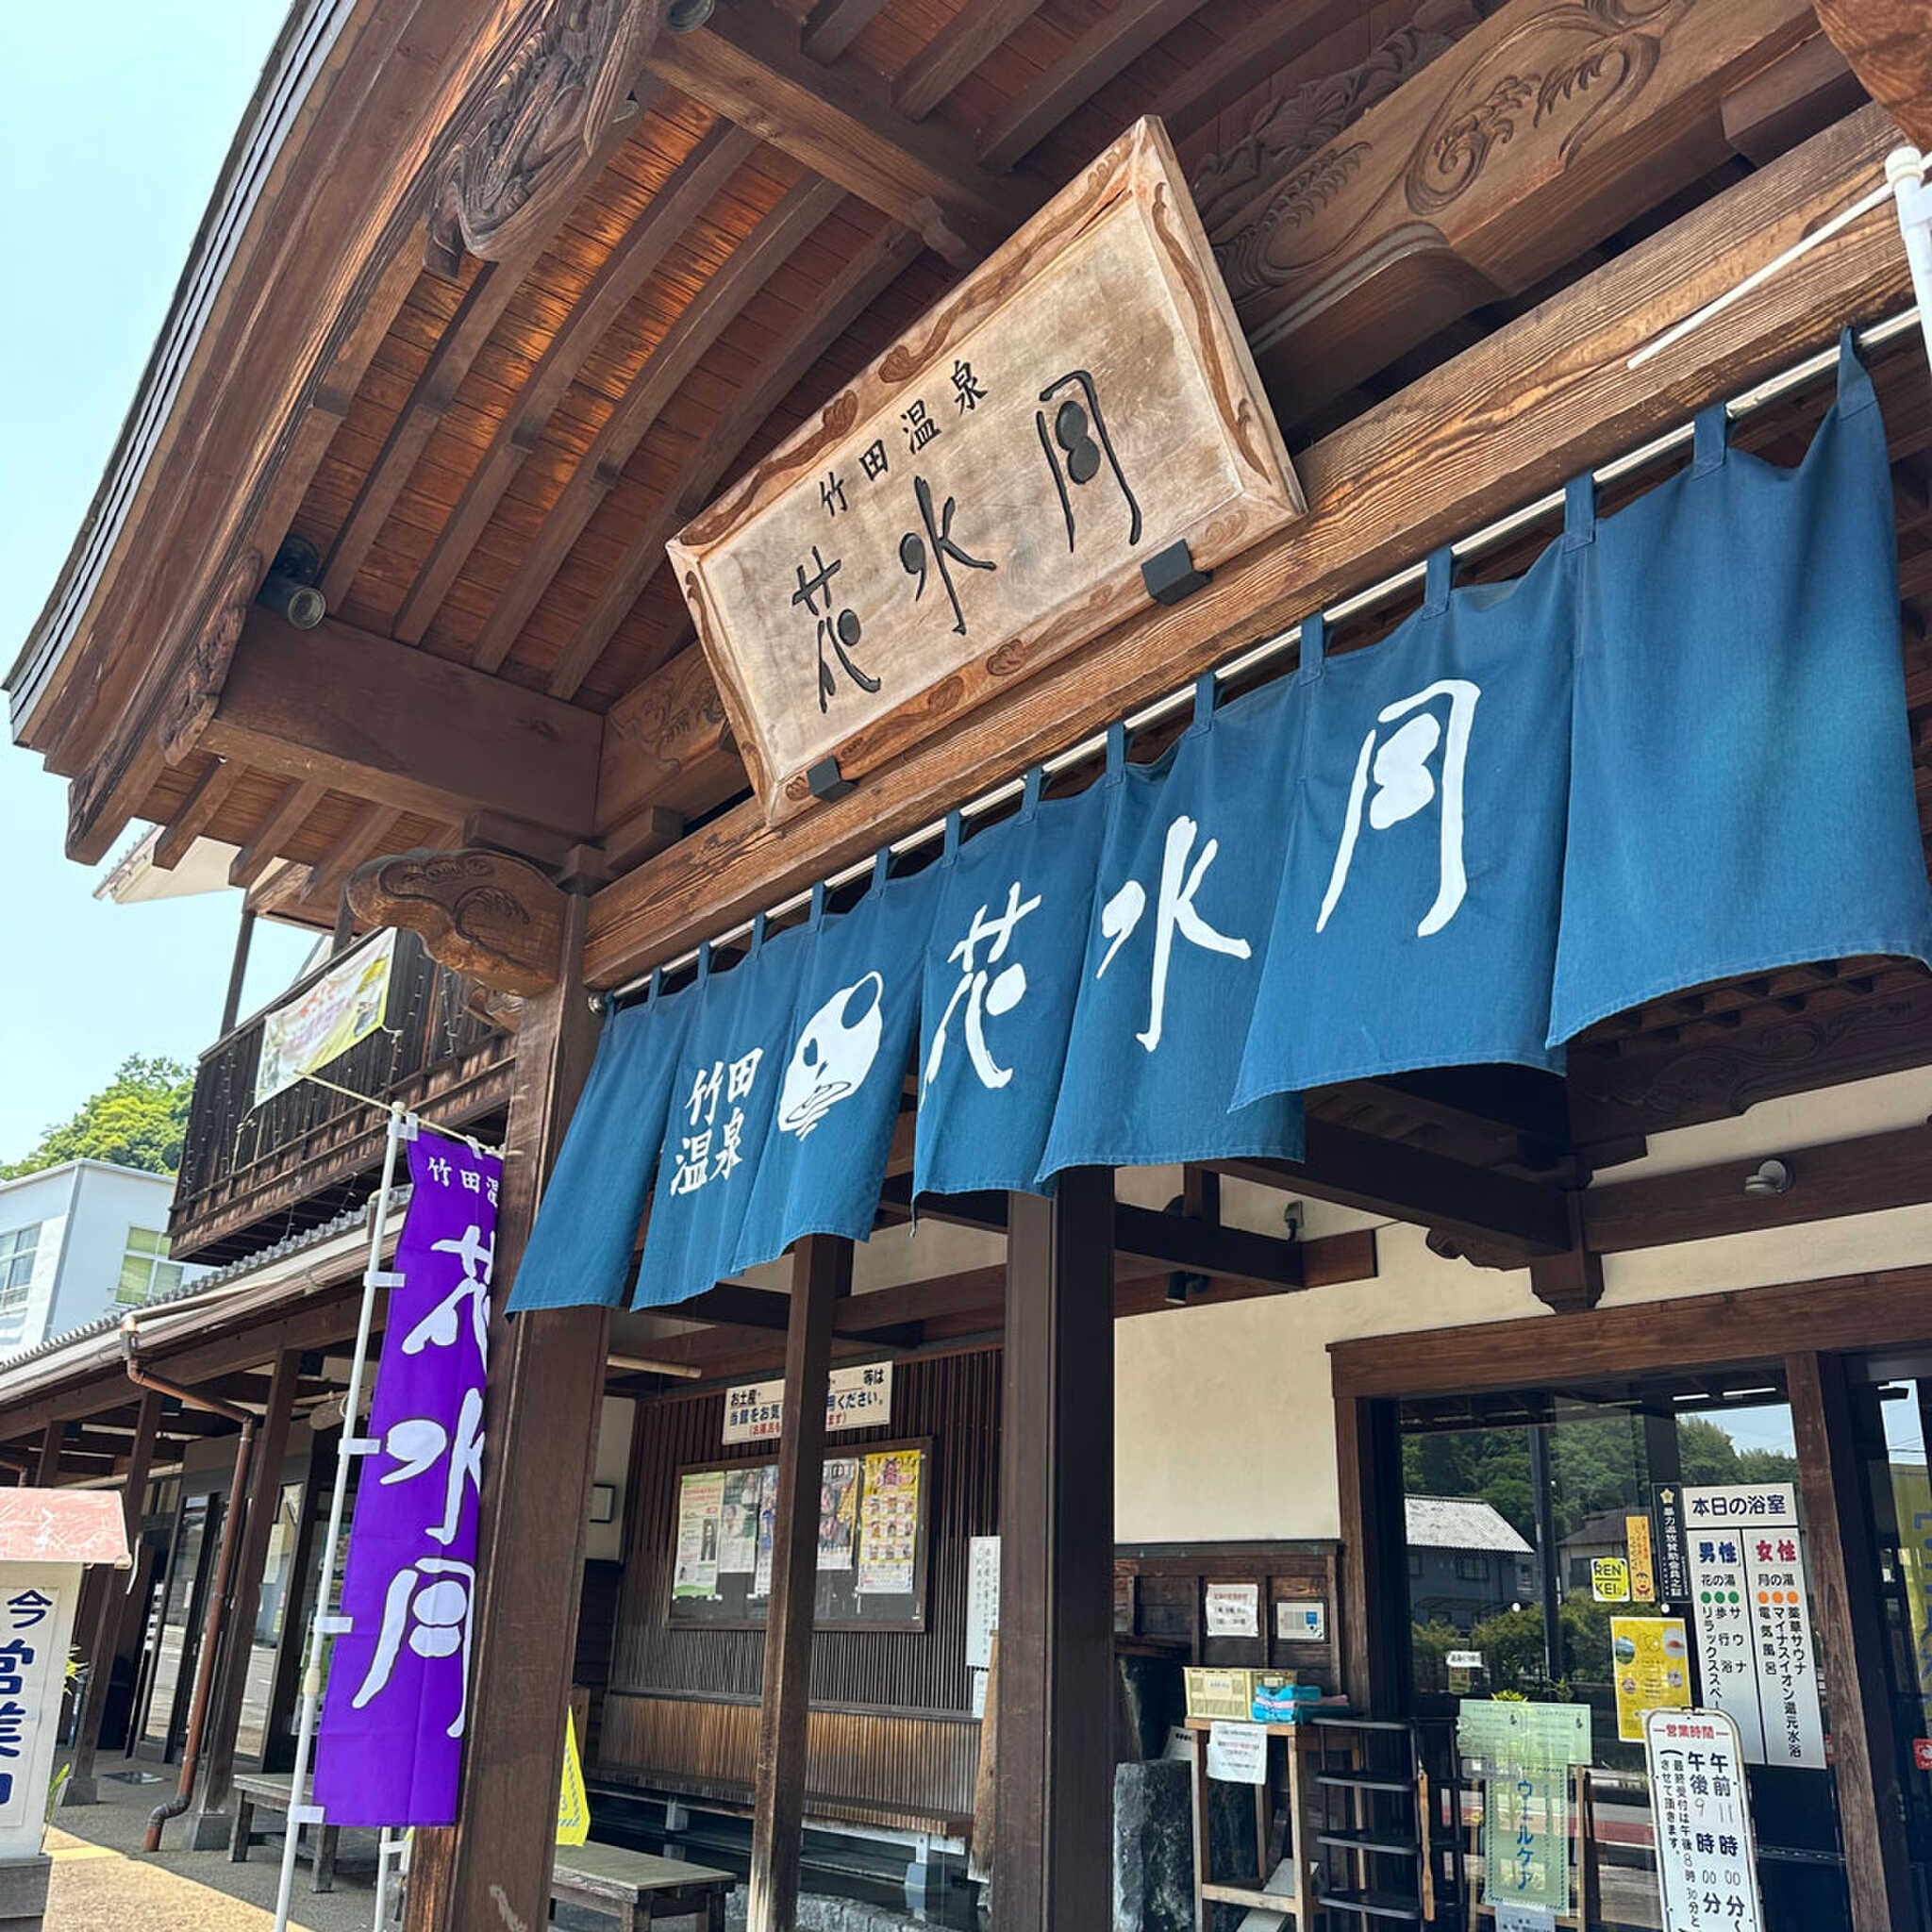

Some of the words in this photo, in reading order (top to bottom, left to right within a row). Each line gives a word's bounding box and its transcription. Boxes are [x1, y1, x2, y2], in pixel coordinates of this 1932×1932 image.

[819, 359, 988, 517] 竹田温泉
[791, 369, 1142, 713] 花水月
[919, 679, 1482, 1112] 花水月
[1692, 1494, 1786, 1517] 本日の浴室
[1699, 1541, 1737, 1563] 男性
[1756, 1540, 1796, 1562] 女性
[1594, 1563, 1622, 1576] REN
[1701, 1574, 1736, 1587] 花の湯
[1757, 1574, 1794, 1587] 月の湯
[1729, 1607, 1747, 1674] サウナ
[1758, 1607, 1777, 1675] 電気風呂
[1666, 1724, 1714, 1740] 営業時間
[1516, 1780, 1534, 1890] ウェルケア
